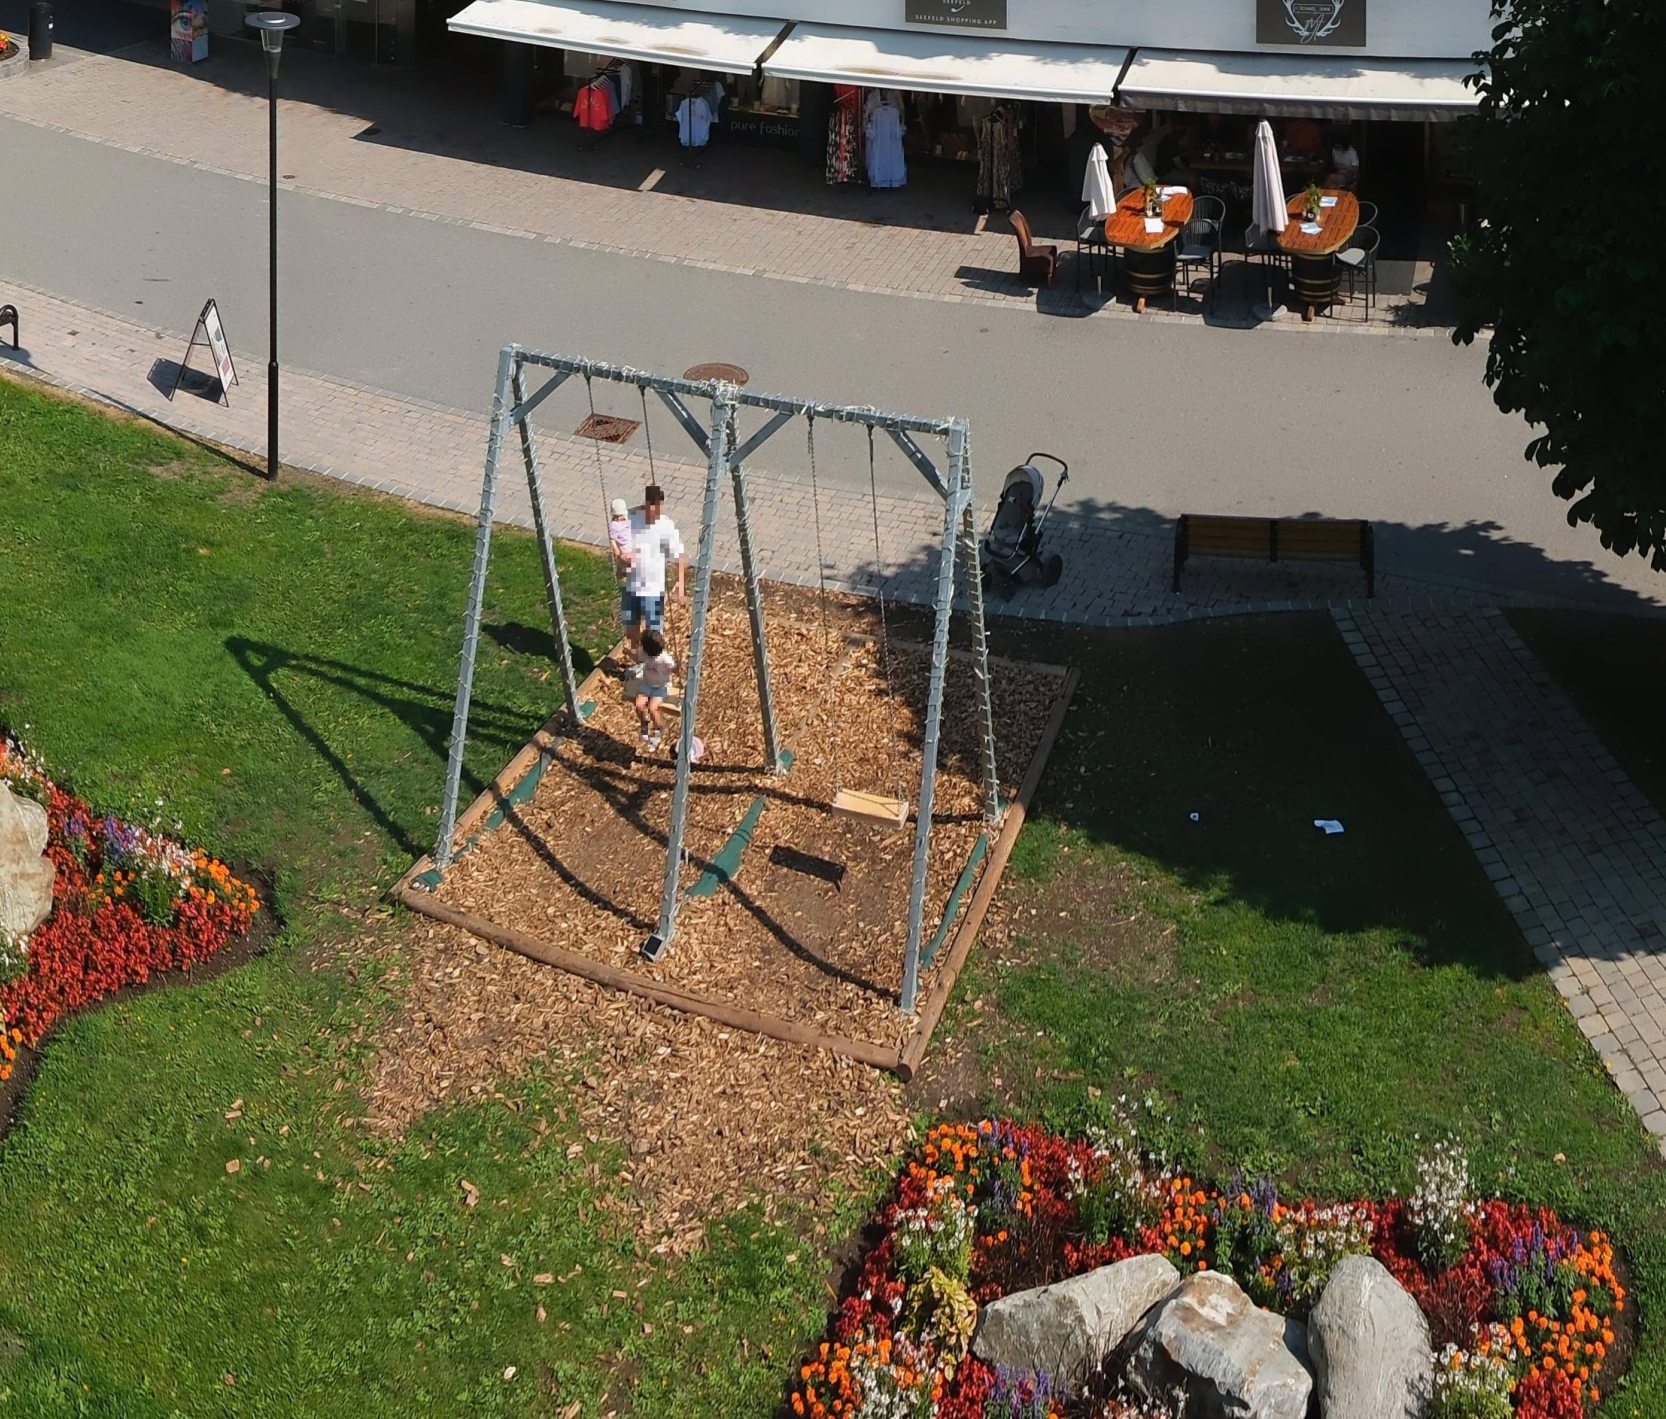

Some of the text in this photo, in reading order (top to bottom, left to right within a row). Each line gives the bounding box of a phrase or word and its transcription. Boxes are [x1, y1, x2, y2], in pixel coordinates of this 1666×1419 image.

[915, 14, 944, 22] SEEFELD
[946, 16, 982, 24] SHOPPING
[730, 121, 756, 132] pure
